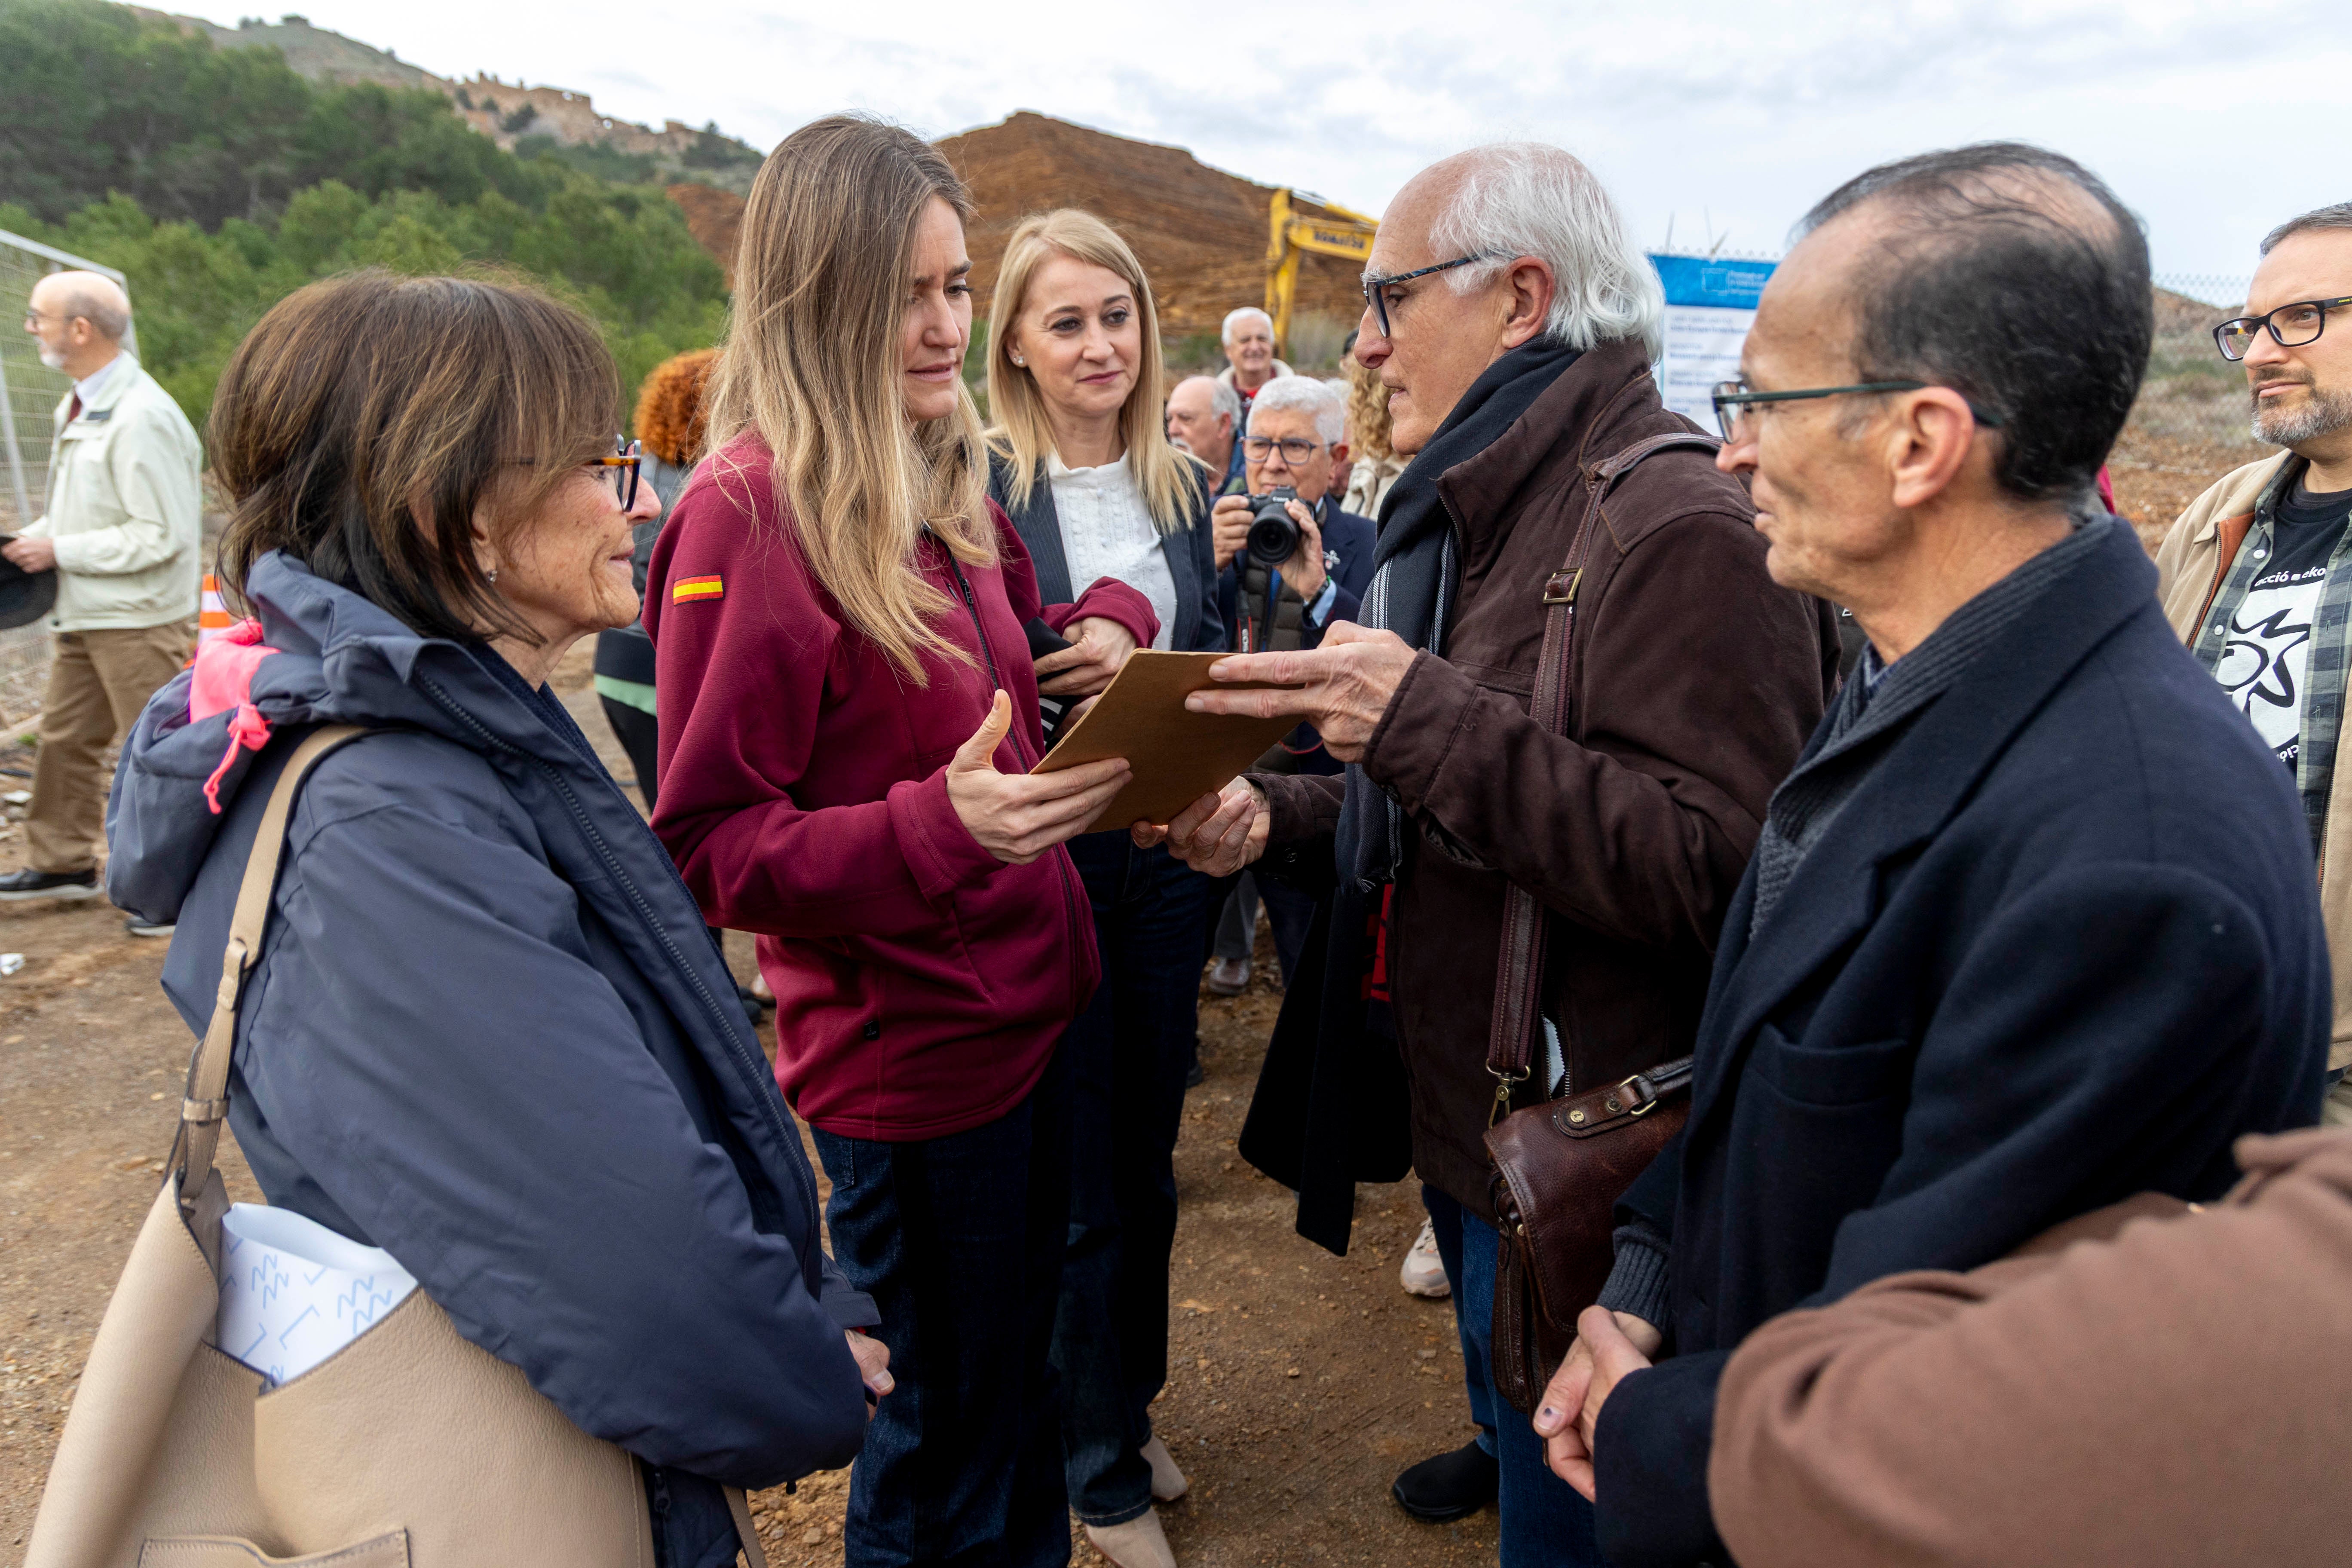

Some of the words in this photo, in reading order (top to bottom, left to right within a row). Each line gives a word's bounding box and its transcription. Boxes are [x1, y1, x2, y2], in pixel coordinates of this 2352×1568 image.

[2254, 570, 2289, 587] acció
[2301, 566, 2327, 579] eko
[2276, 744, 2299, 763] ció
